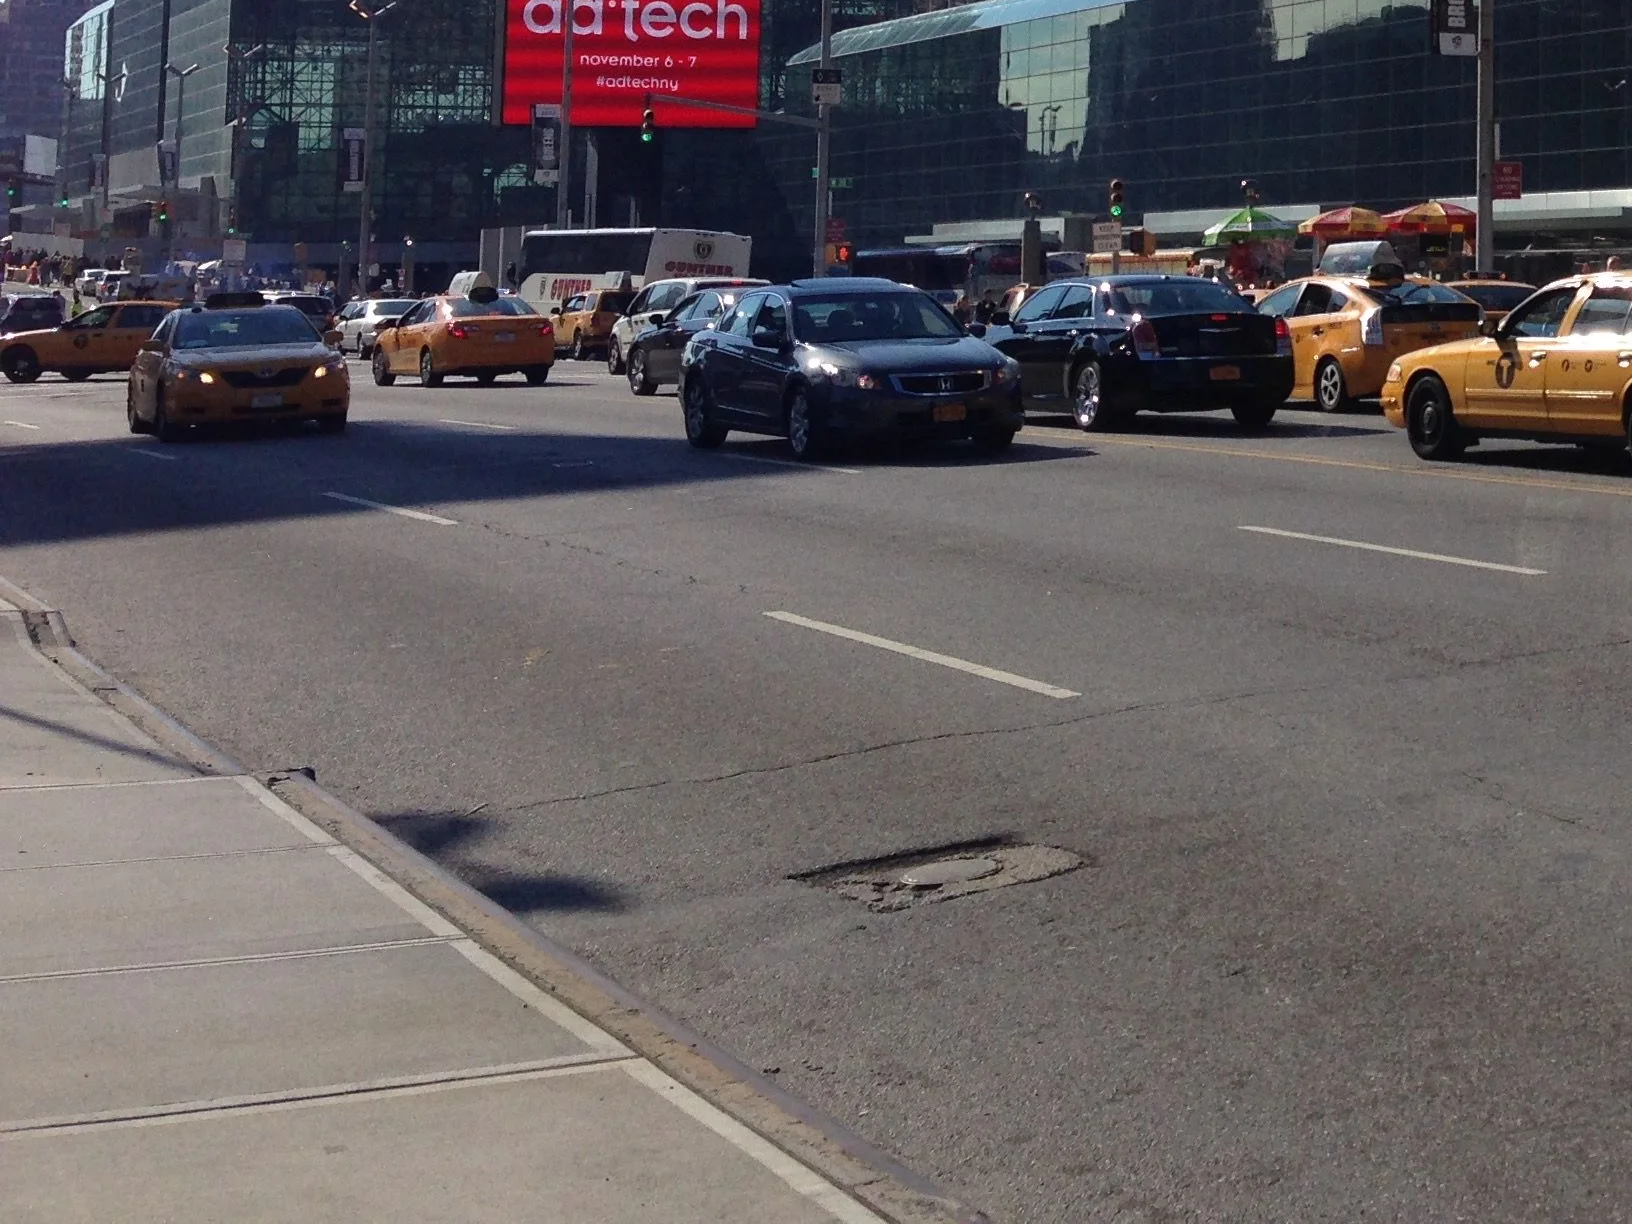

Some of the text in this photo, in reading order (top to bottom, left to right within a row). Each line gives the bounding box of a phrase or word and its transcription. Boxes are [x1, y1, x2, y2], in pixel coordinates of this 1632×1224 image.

[580, 54, 659, 67] november
[664, 55, 674, 67] 6
[688, 56, 697, 67] 7
[596, 75, 679, 92] #adtechny
